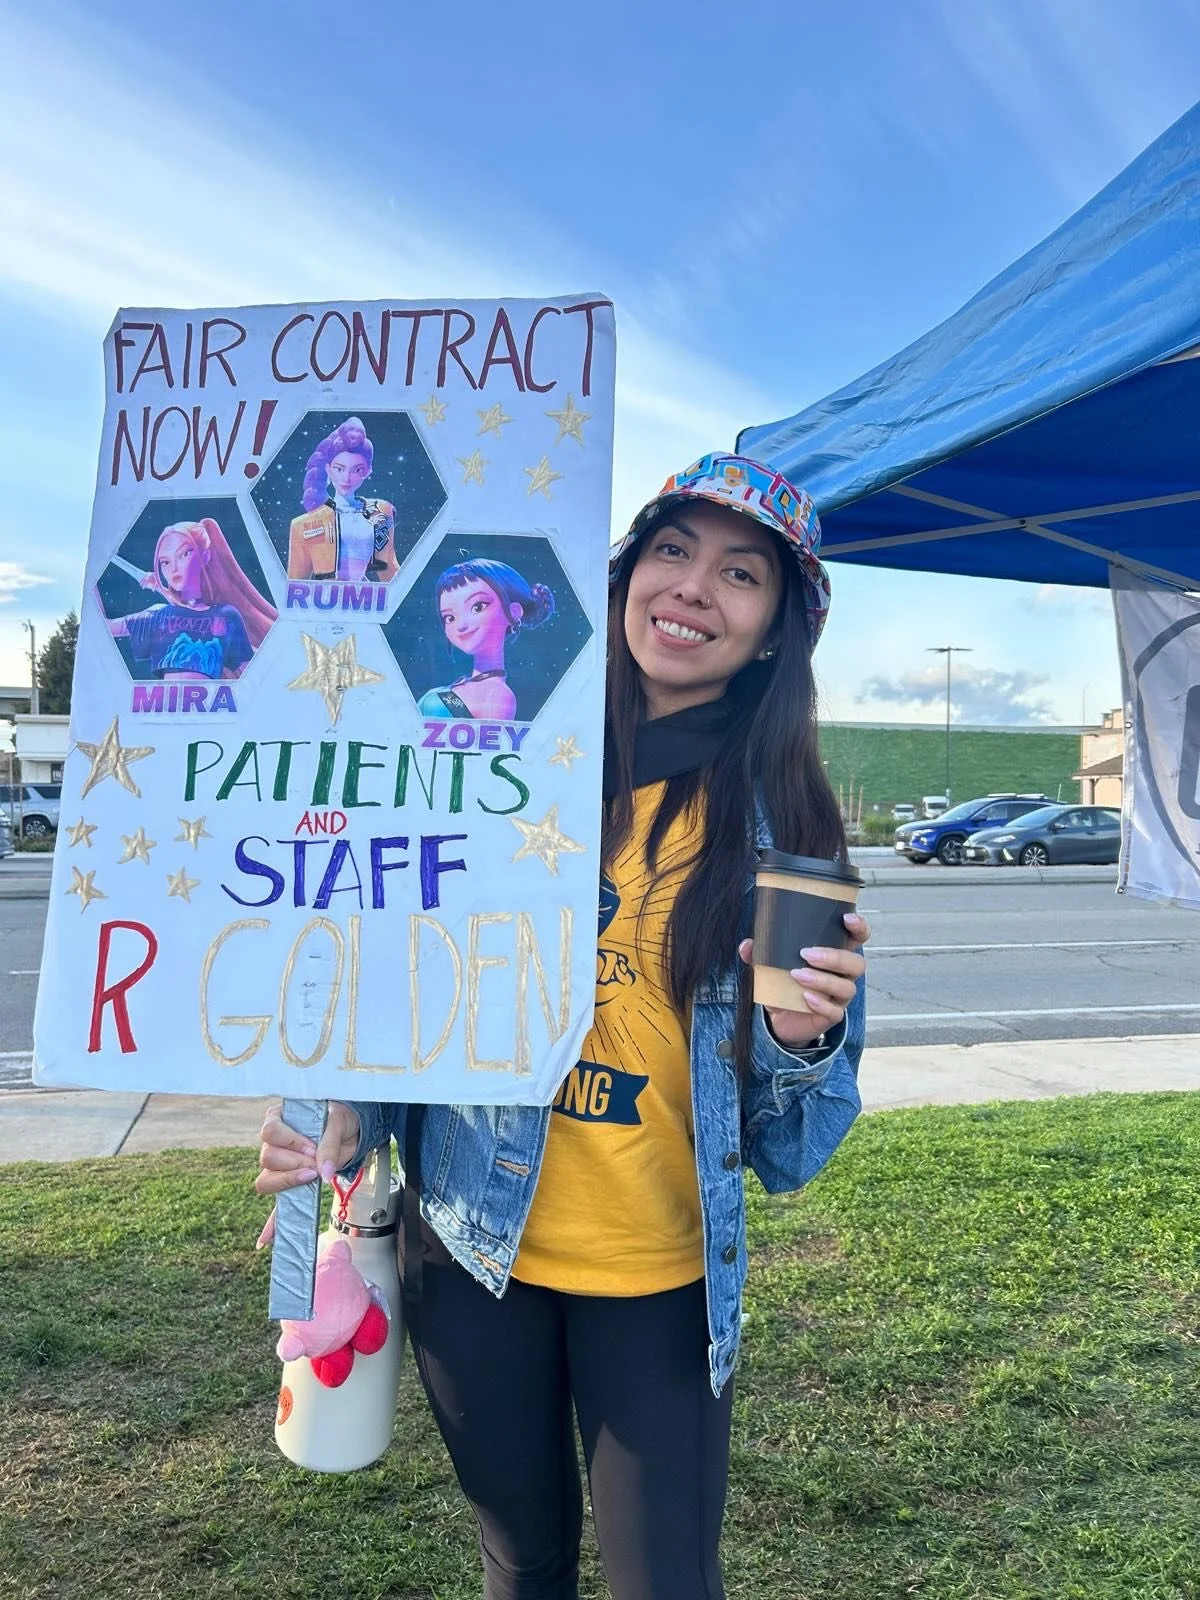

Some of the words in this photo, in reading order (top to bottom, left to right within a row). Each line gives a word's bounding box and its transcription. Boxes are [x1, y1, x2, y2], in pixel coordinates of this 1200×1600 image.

[114, 317, 248, 394] FAIR
[271, 300, 615, 397] CONTRACT
[111, 399, 279, 486] NOW!
[286, 583, 387, 612] RUMI
[131, 684, 238, 714] MIRA
[421, 721, 532, 752] ZOEY
[183, 739, 532, 815] PATIENTS
[295, 810, 348, 836] AND
[220, 833, 468, 910] STAFF
[87, 919, 159, 1054] R
[199, 906, 573, 1076] GOLDEN
